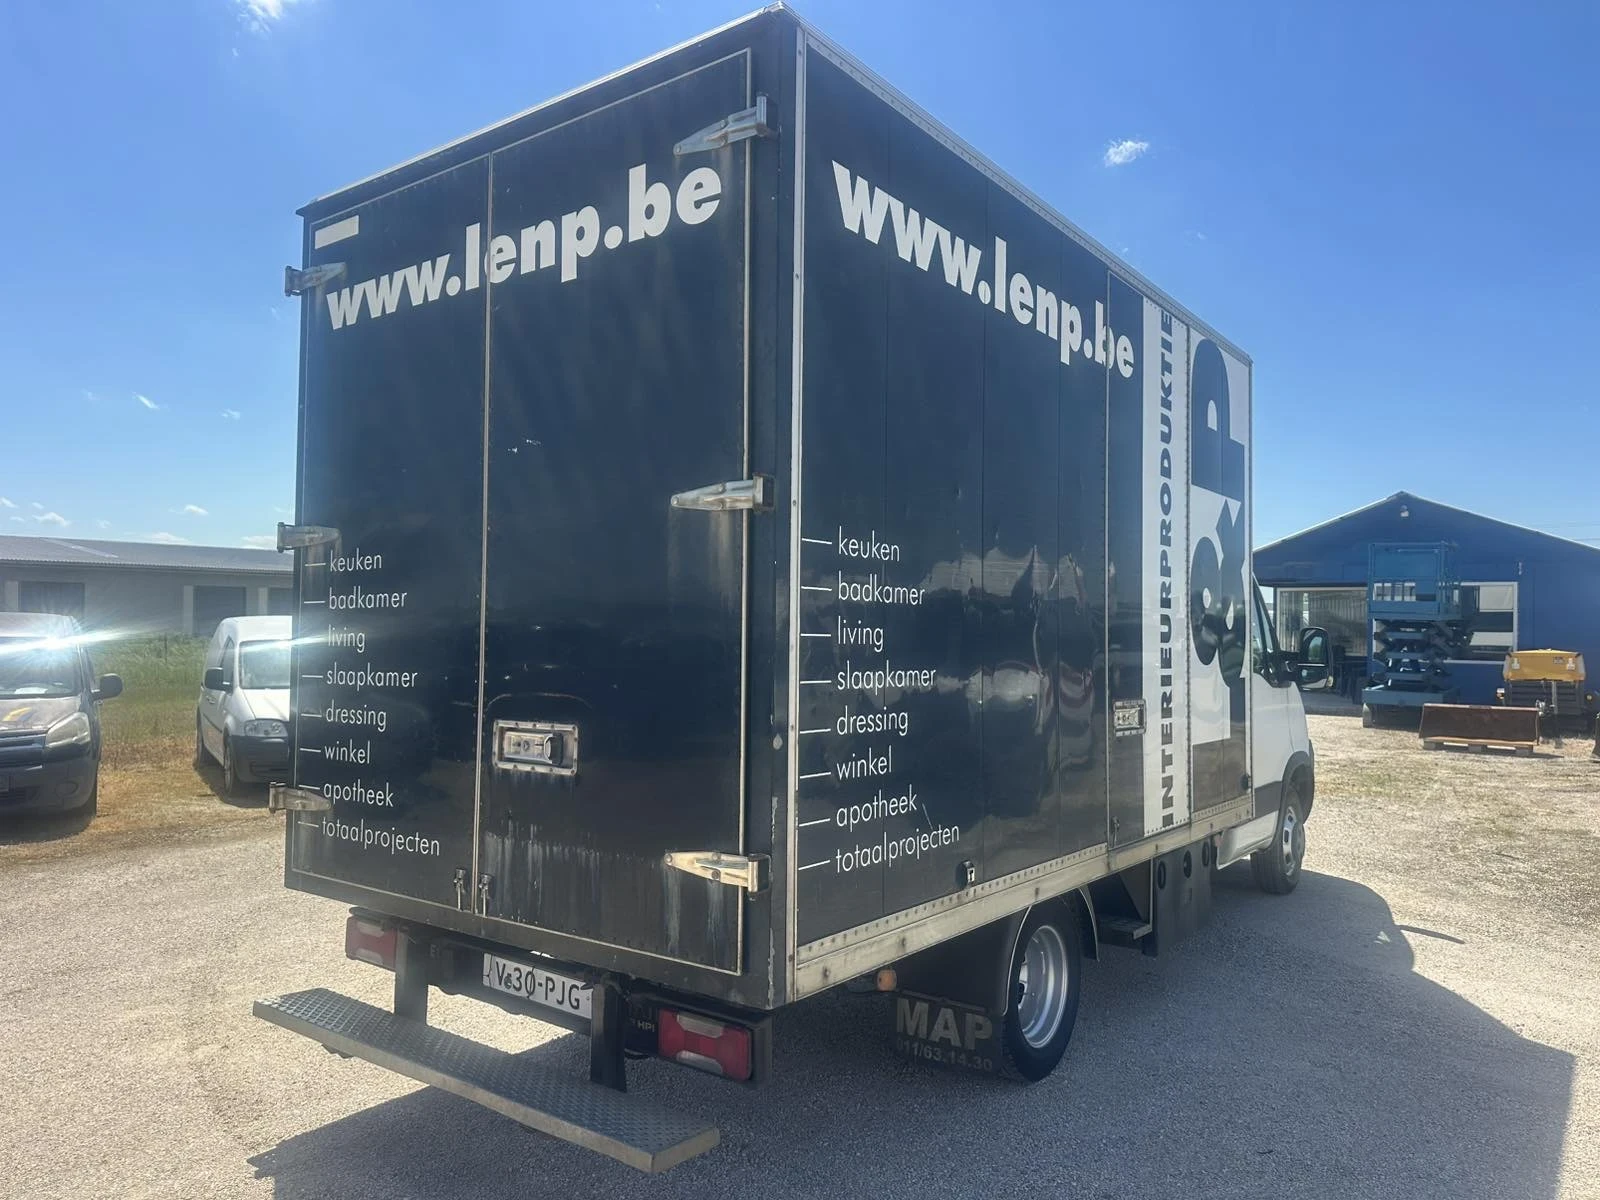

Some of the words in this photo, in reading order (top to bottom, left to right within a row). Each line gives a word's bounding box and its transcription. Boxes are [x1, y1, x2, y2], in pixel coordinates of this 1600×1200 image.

[326, 162, 722, 330] www.lenp.be
[832, 160, 1135, 378] www.lenp.be
[330, 548, 382, 572] keuken
[838, 525, 900, 562] keuken
[1160, 310, 1175, 828] INTERIEURPRODUKTIE
[329, 585, 407, 610] badkamer
[838, 570, 926, 605] badkamer
[328, 624, 366, 653] living
[837, 615, 884, 653] living
[326, 662, 418, 691] slaapkamer
[837, 660, 937, 696] slaapkamer
[325, 699, 387, 732] dressing
[836, 705, 909, 736] dressing
[324, 739, 371, 764] winkel
[836, 745, 892, 780] winkel
[323, 779, 394, 807] apotheek
[836, 784, 917, 832] apotheek
[322, 817, 440, 856] totaalprojecten
[835, 825, 960, 873] totaalprojecten
[896, 997, 993, 1050] MAP
